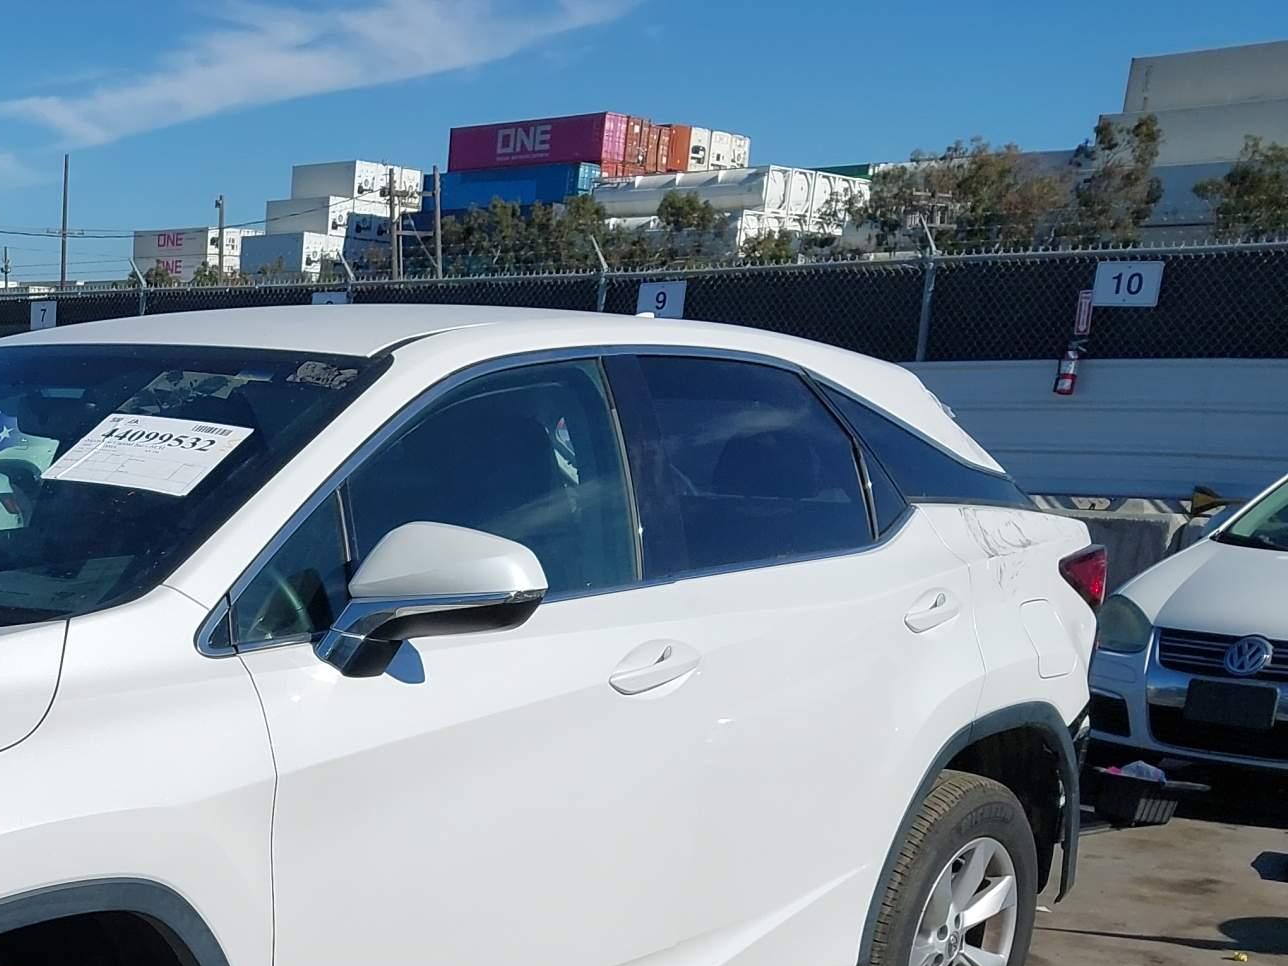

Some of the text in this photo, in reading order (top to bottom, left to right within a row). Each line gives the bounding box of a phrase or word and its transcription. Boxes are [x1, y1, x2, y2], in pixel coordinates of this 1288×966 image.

[496, 124, 552, 155] ONE
[157, 232, 185, 248] ONE
[1112, 272, 1144, 296] 10
[655, 291, 667, 310] 9
[40, 308, 47, 322] 7
[101, 428, 216, 452] 44099532
